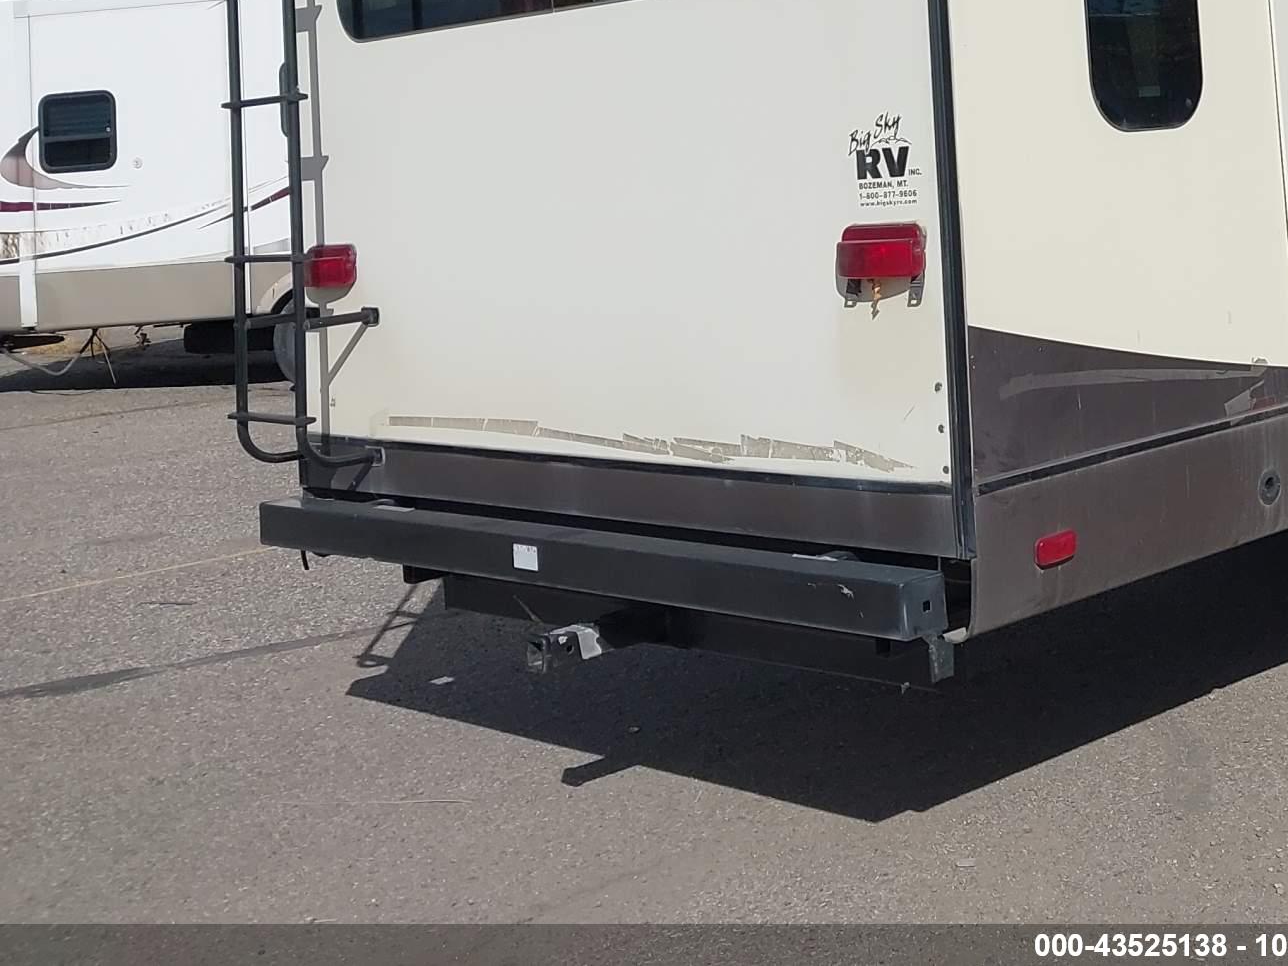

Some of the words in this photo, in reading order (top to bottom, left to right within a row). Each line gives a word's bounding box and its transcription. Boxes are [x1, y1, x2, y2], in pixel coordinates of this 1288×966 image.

[848, 129, 872, 156] Big
[873, 112, 902, 140] Sky
[856, 146, 910, 180] RV
[908, 168, 922, 176] INC.
[858, 181, 895, 190] BOZEMAN,
[896, 180, 909, 188] MT.
